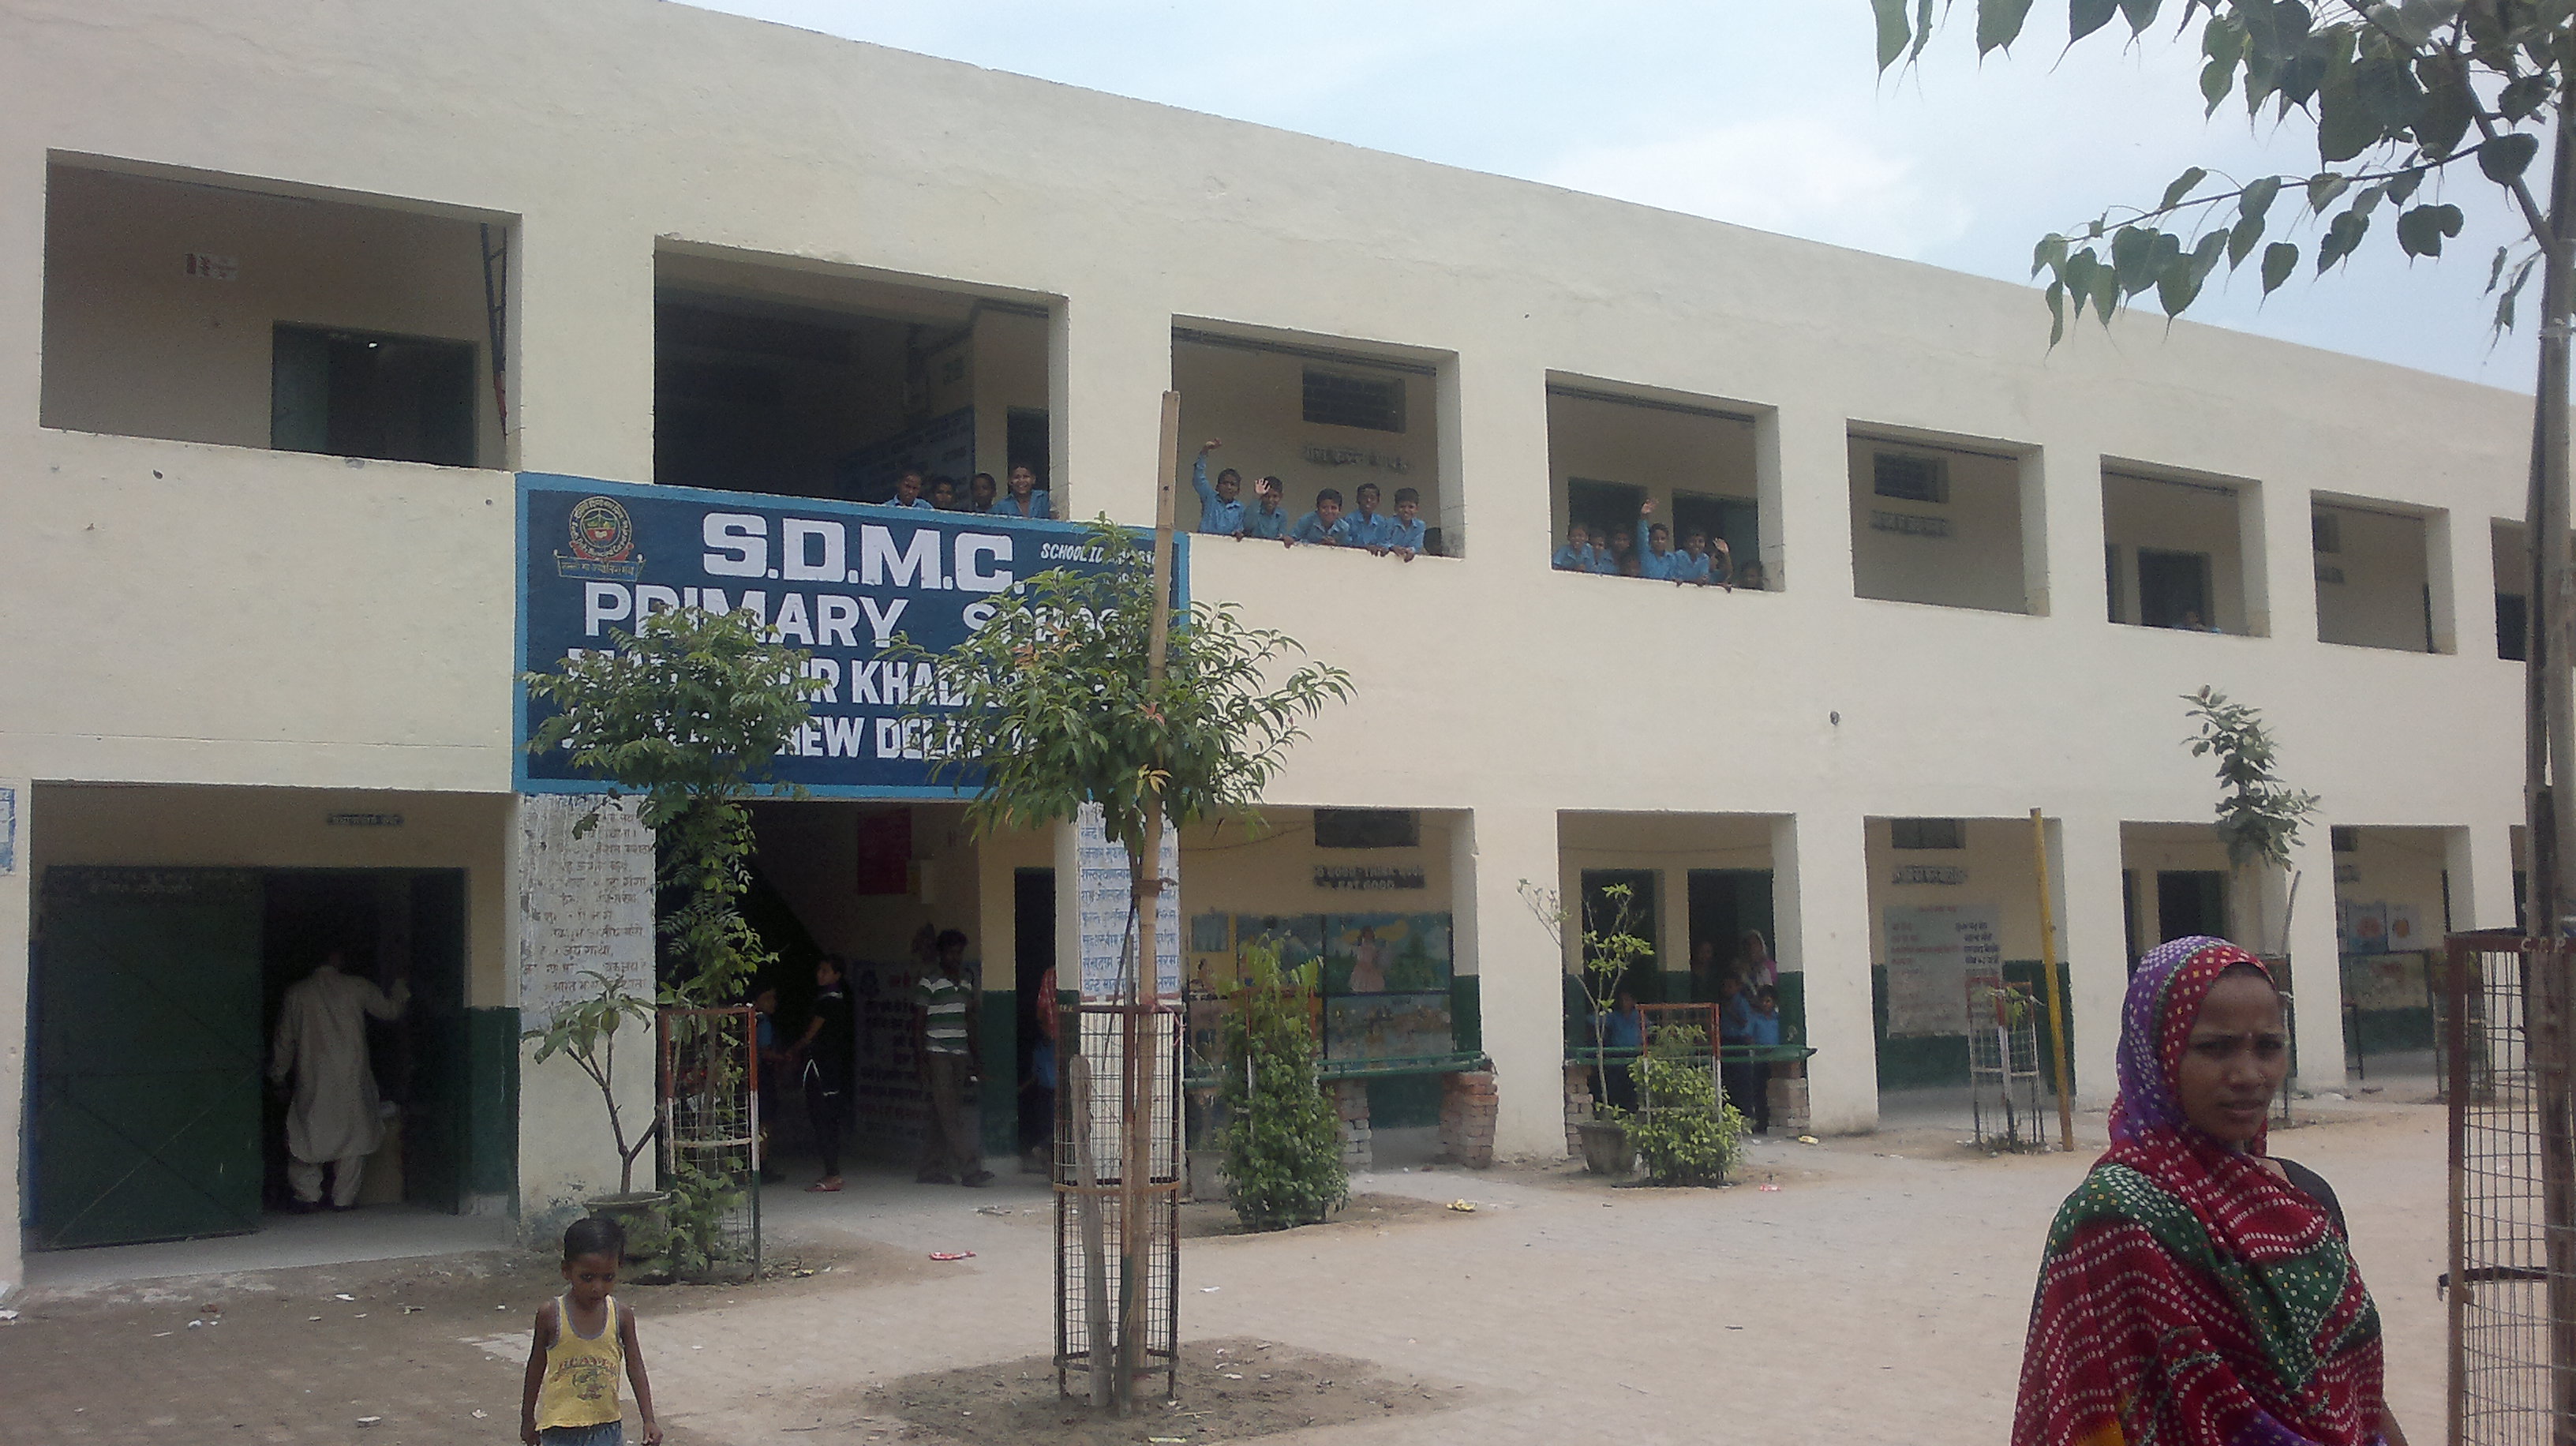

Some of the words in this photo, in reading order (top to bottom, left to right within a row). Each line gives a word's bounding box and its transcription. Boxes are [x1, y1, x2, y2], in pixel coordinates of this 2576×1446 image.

[703, 512, 1025, 594] S.D.M.C.
[1040, 541, 1088, 564] SCHOOL
[586, 581, 909, 648] PRIMARY
